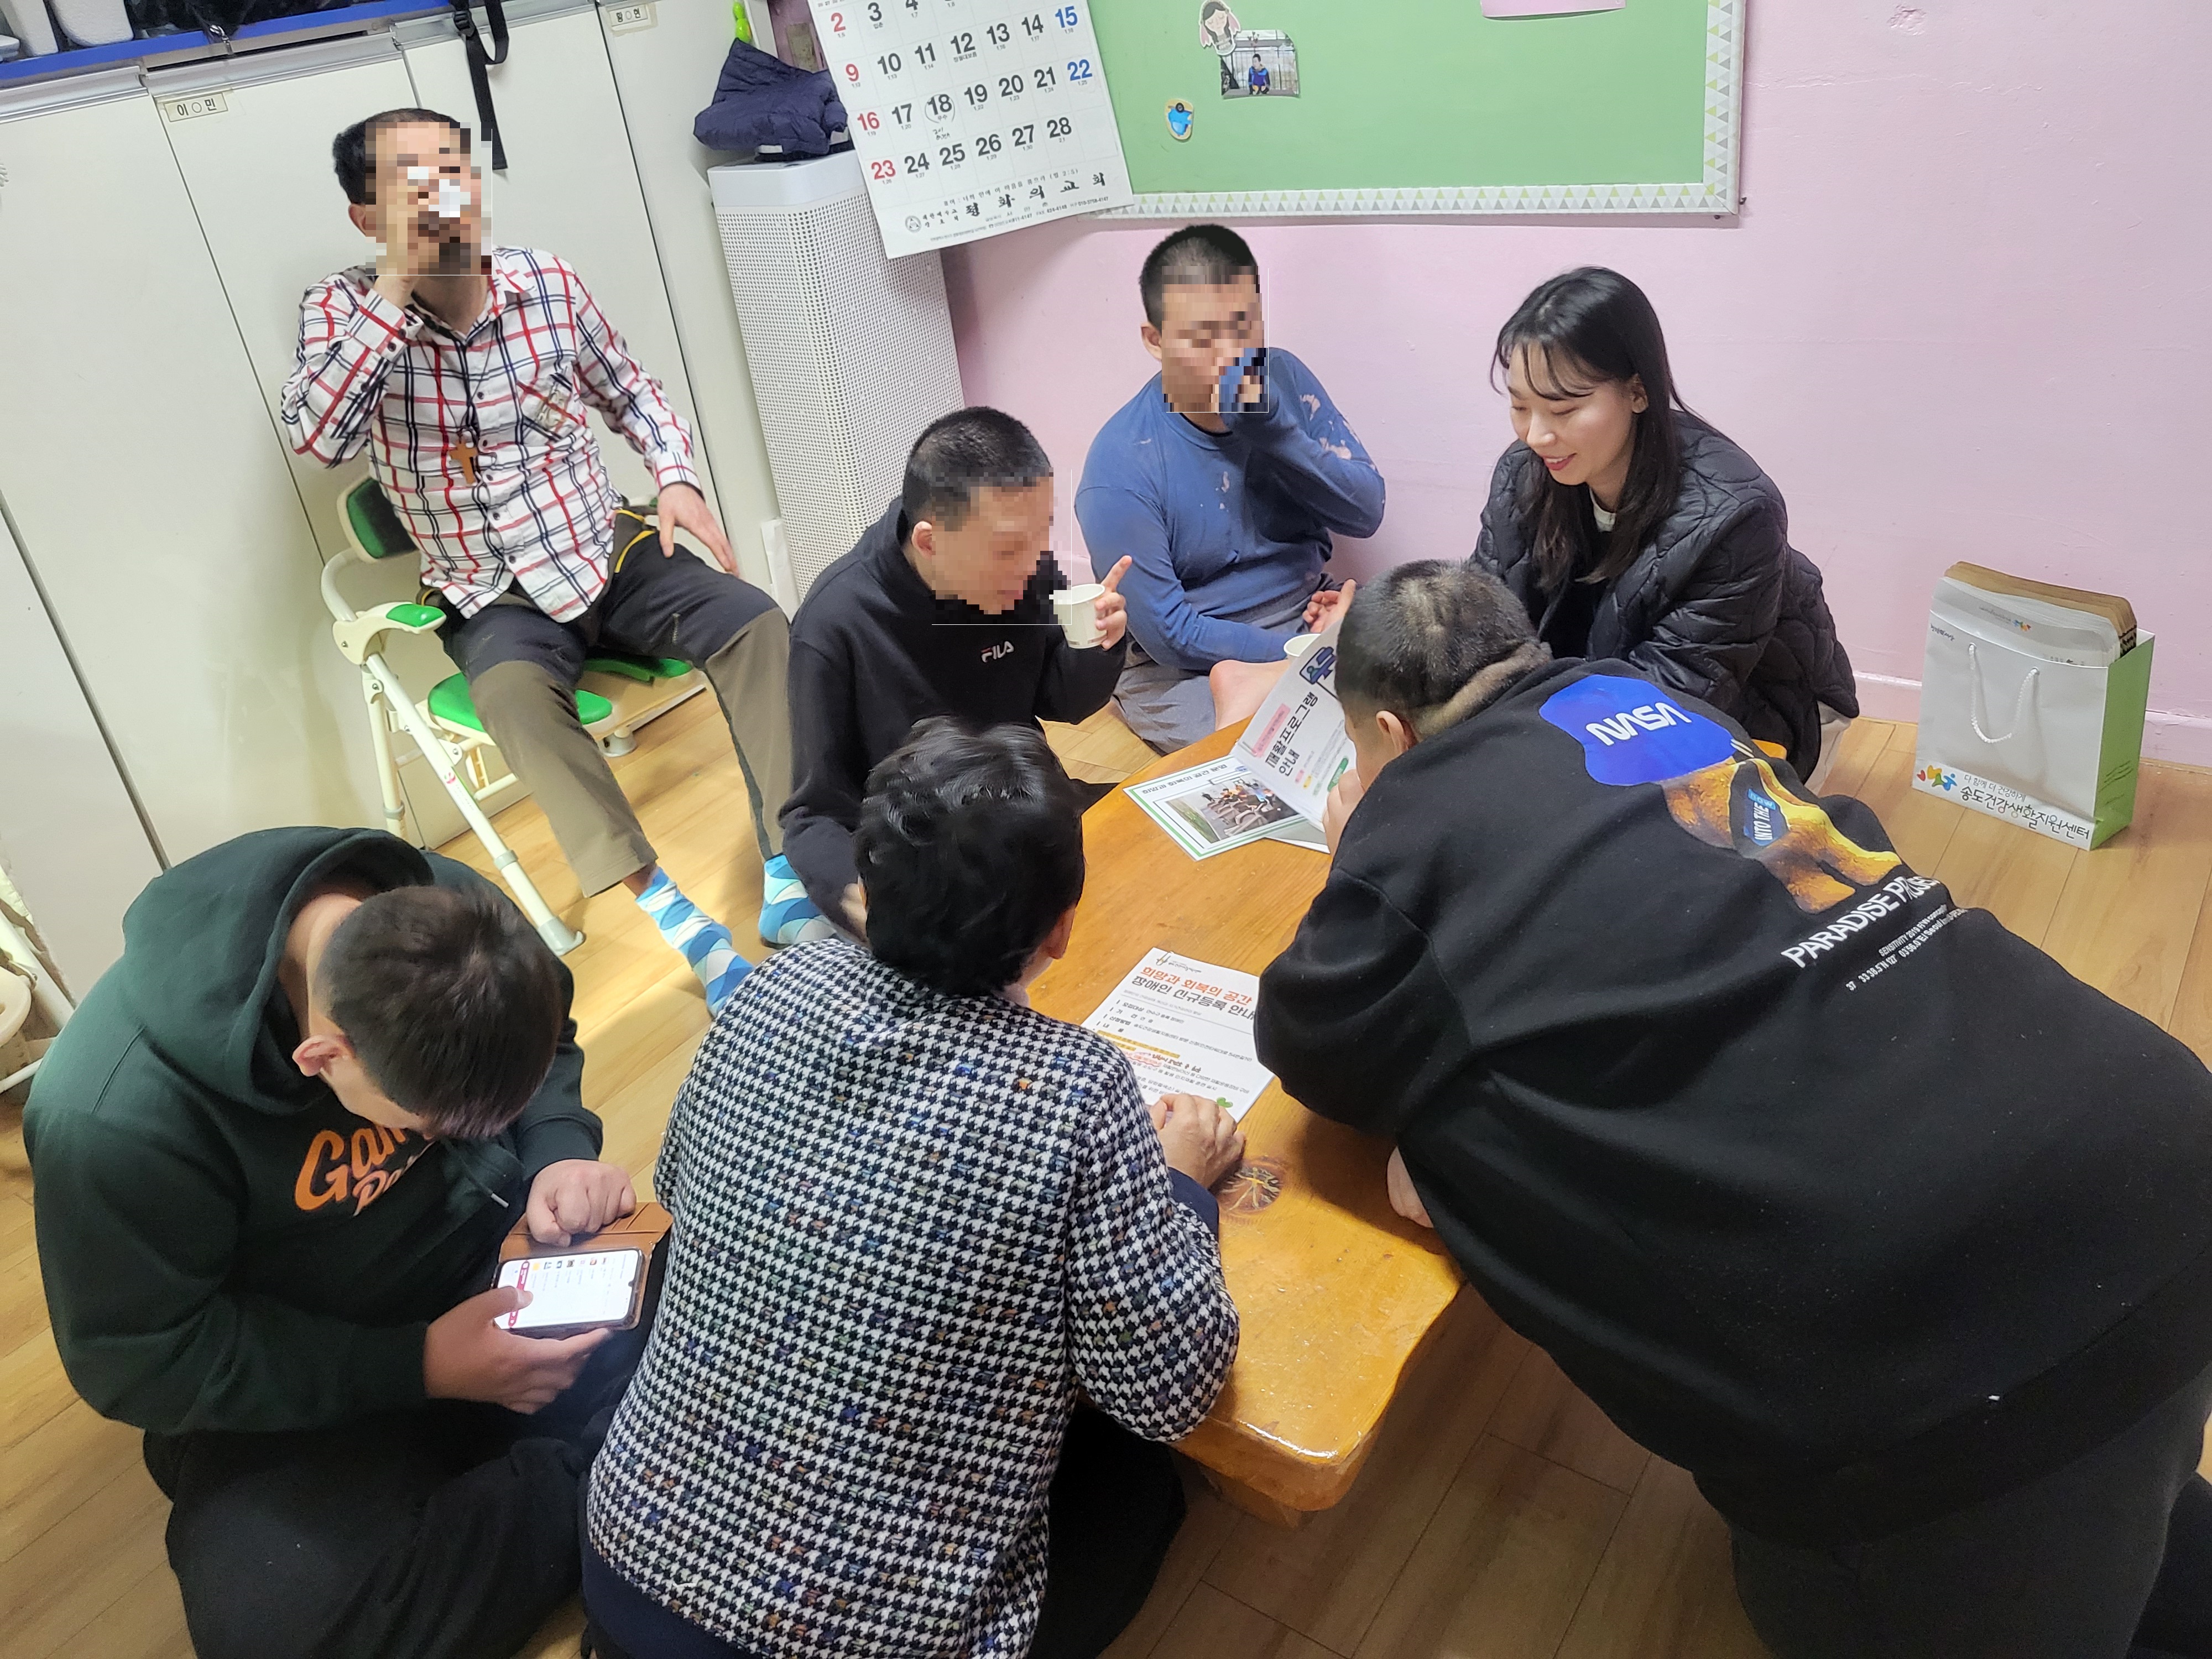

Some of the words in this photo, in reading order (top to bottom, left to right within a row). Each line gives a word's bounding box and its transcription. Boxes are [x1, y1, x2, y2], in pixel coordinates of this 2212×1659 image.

[831, 12, 846, 32] 2
[868, 2, 882, 22] 3
[846, 64, 859, 82] 9
[877, 53, 901, 75] 10
[914, 43, 936, 65] 11
[950, 33, 976, 55] 12
[986, 23, 1010, 45] 13
[1021, 14, 1044, 36] 14
[1055, 6, 1078, 28] 15
[857, 112, 880, 131] 16
[891, 103, 912, 124] 17
[927, 94, 952, 116] 18
[964, 84, 988, 106] 19
[998, 75, 1024, 97] 20
[1034, 66, 1057, 88] 21
[1067, 59, 1093, 81] 22
[871, 160, 896, 180] 23
[904, 153, 930, 174] 24
[939, 143, 966, 166] 25
[975, 134, 1001, 156] 26
[1012, 124, 1034, 147] 27
[1047, 117, 1072, 139] 28
[981, 641, 1014, 662] FILA
[1585, 702, 1693, 746] NASA
[1279, 749, 1300, 777] 안내
[1964, 774, 1971, 783] 다
[1973, 777, 1987, 789] 함께
[1989, 782, 1997, 792] 더
[1998, 786, 2027, 802] 건강하게
[1753, 802, 1770, 821] THE
[1960, 786, 2090, 840] 송도건강생활지원센터
[1753, 821, 1773, 840] INTO
[1780, 893, 1901, 968] PARADISE
[1879, 933, 1908, 957] SENSITIVITY
[1906, 926, 1919, 938] 2019
[1131, 975, 1173, 995] 장애인
[1172, 988, 1228, 1011] 신규등록
[1140, 966, 1181, 985] 희망과
[1181, 978, 1223, 997] 회복의
[1223, 990, 1253, 1006] 공간
